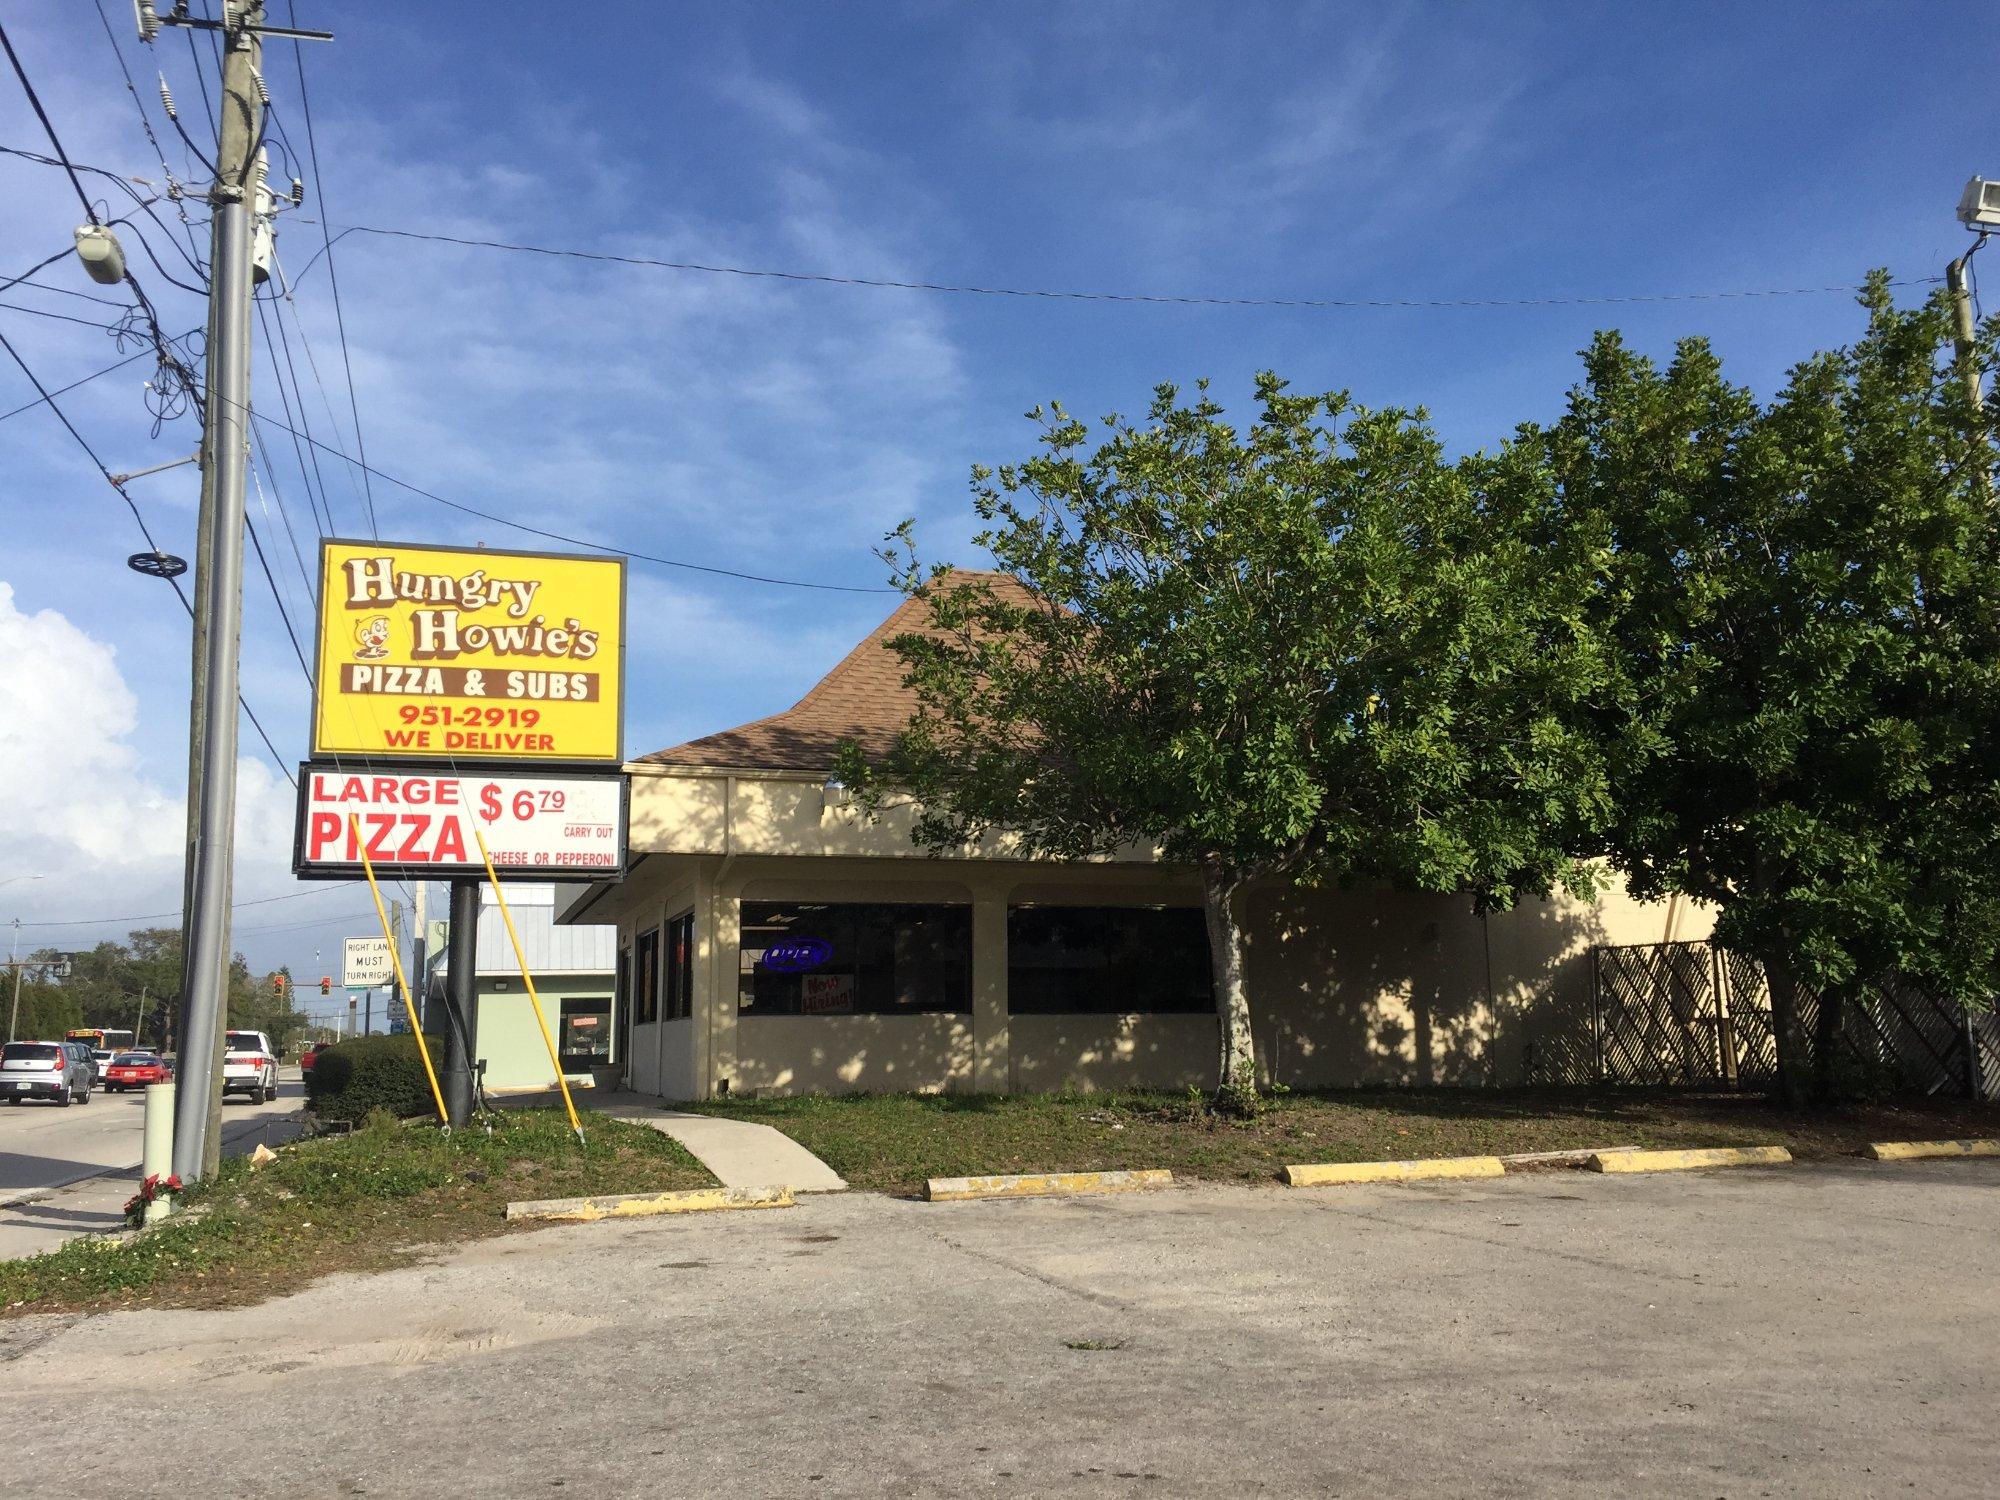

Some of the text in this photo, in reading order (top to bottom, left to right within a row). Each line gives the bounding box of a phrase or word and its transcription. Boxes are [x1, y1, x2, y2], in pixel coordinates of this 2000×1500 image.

[341, 557, 541, 618] Hungry
[410, 608, 599, 660] Howie's
[352, 665, 588, 700] PIZZA & SUBS
[399, 705, 540, 728] 951-2919
[384, 730, 555, 751] WE DELIVER
[313, 776, 459, 804] LARGE
[310, 812, 467, 862] PIZZA
[564, 826, 613, 838] CARRY OUT
[534, 852, 549, 864] OR
[555, 852, 614, 866] PEPPERONI
[356, 956, 383, 966] MUST
[347, 971, 391, 980] TURN RIGHT
